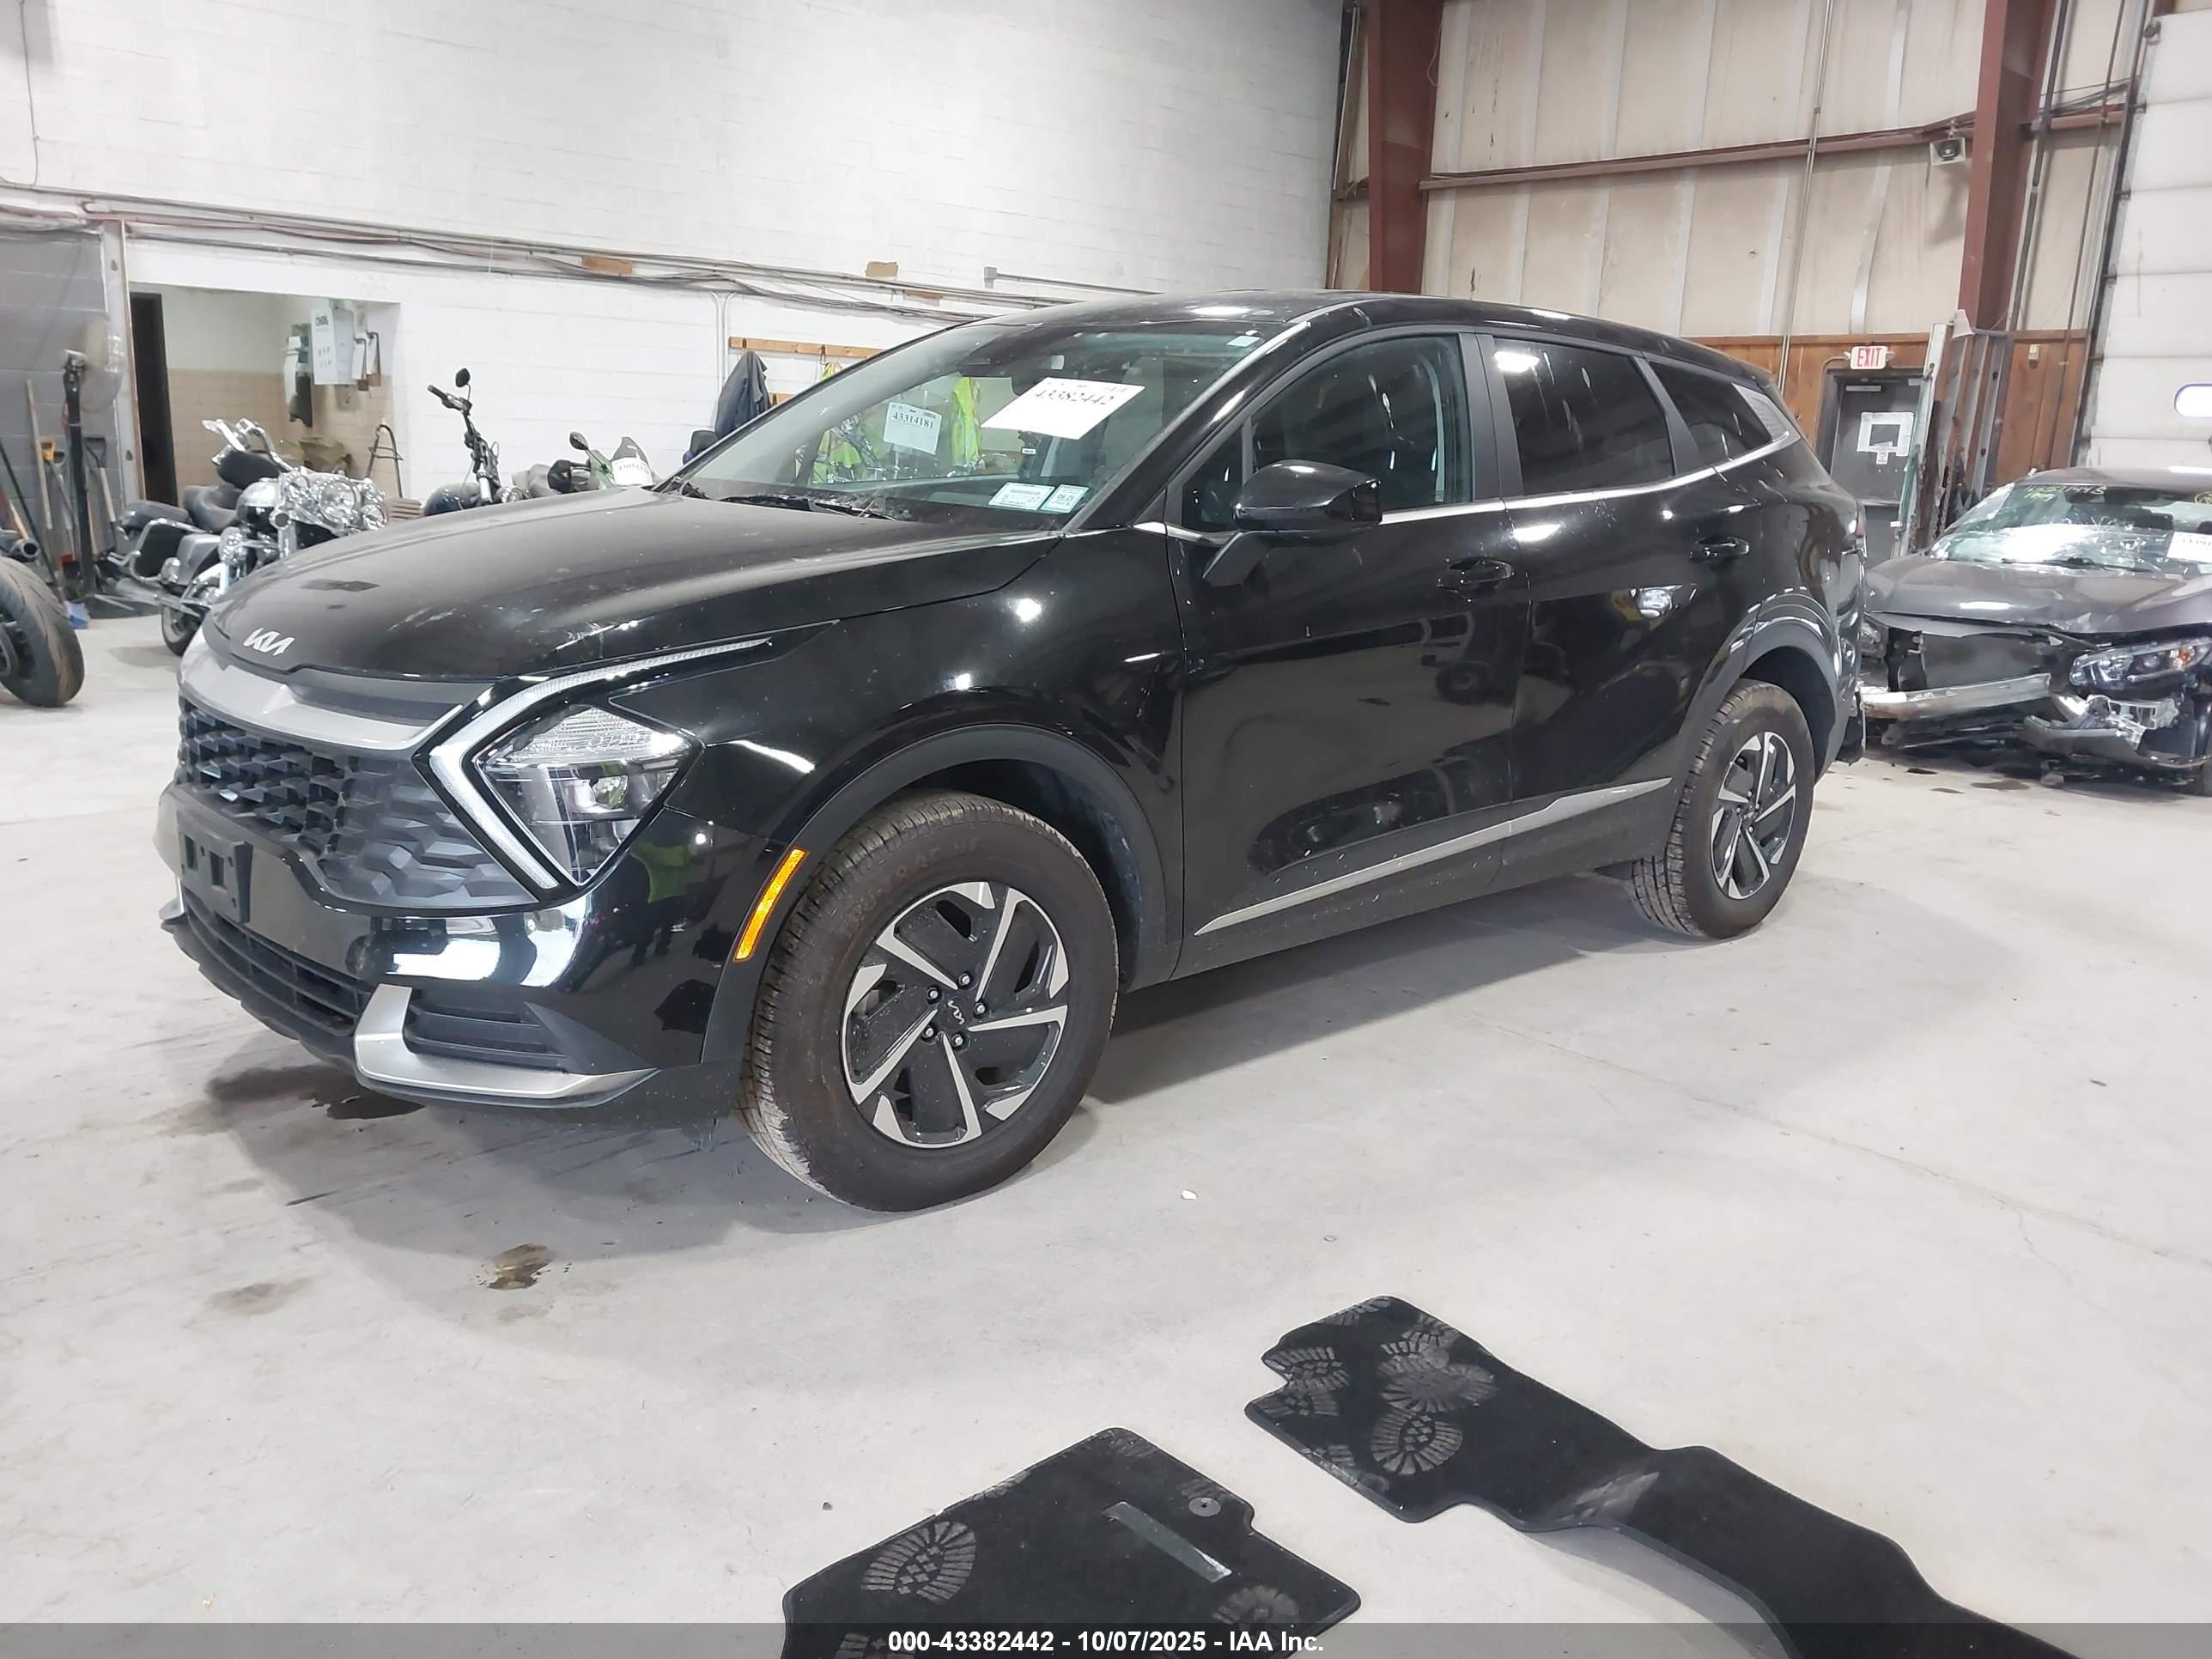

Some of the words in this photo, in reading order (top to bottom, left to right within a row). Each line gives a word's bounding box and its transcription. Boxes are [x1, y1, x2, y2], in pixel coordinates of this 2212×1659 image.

[1856, 347, 1882, 368] EXIT
[1035, 389, 1115, 406] 43382442
[892, 411, 933, 429] 43314181
